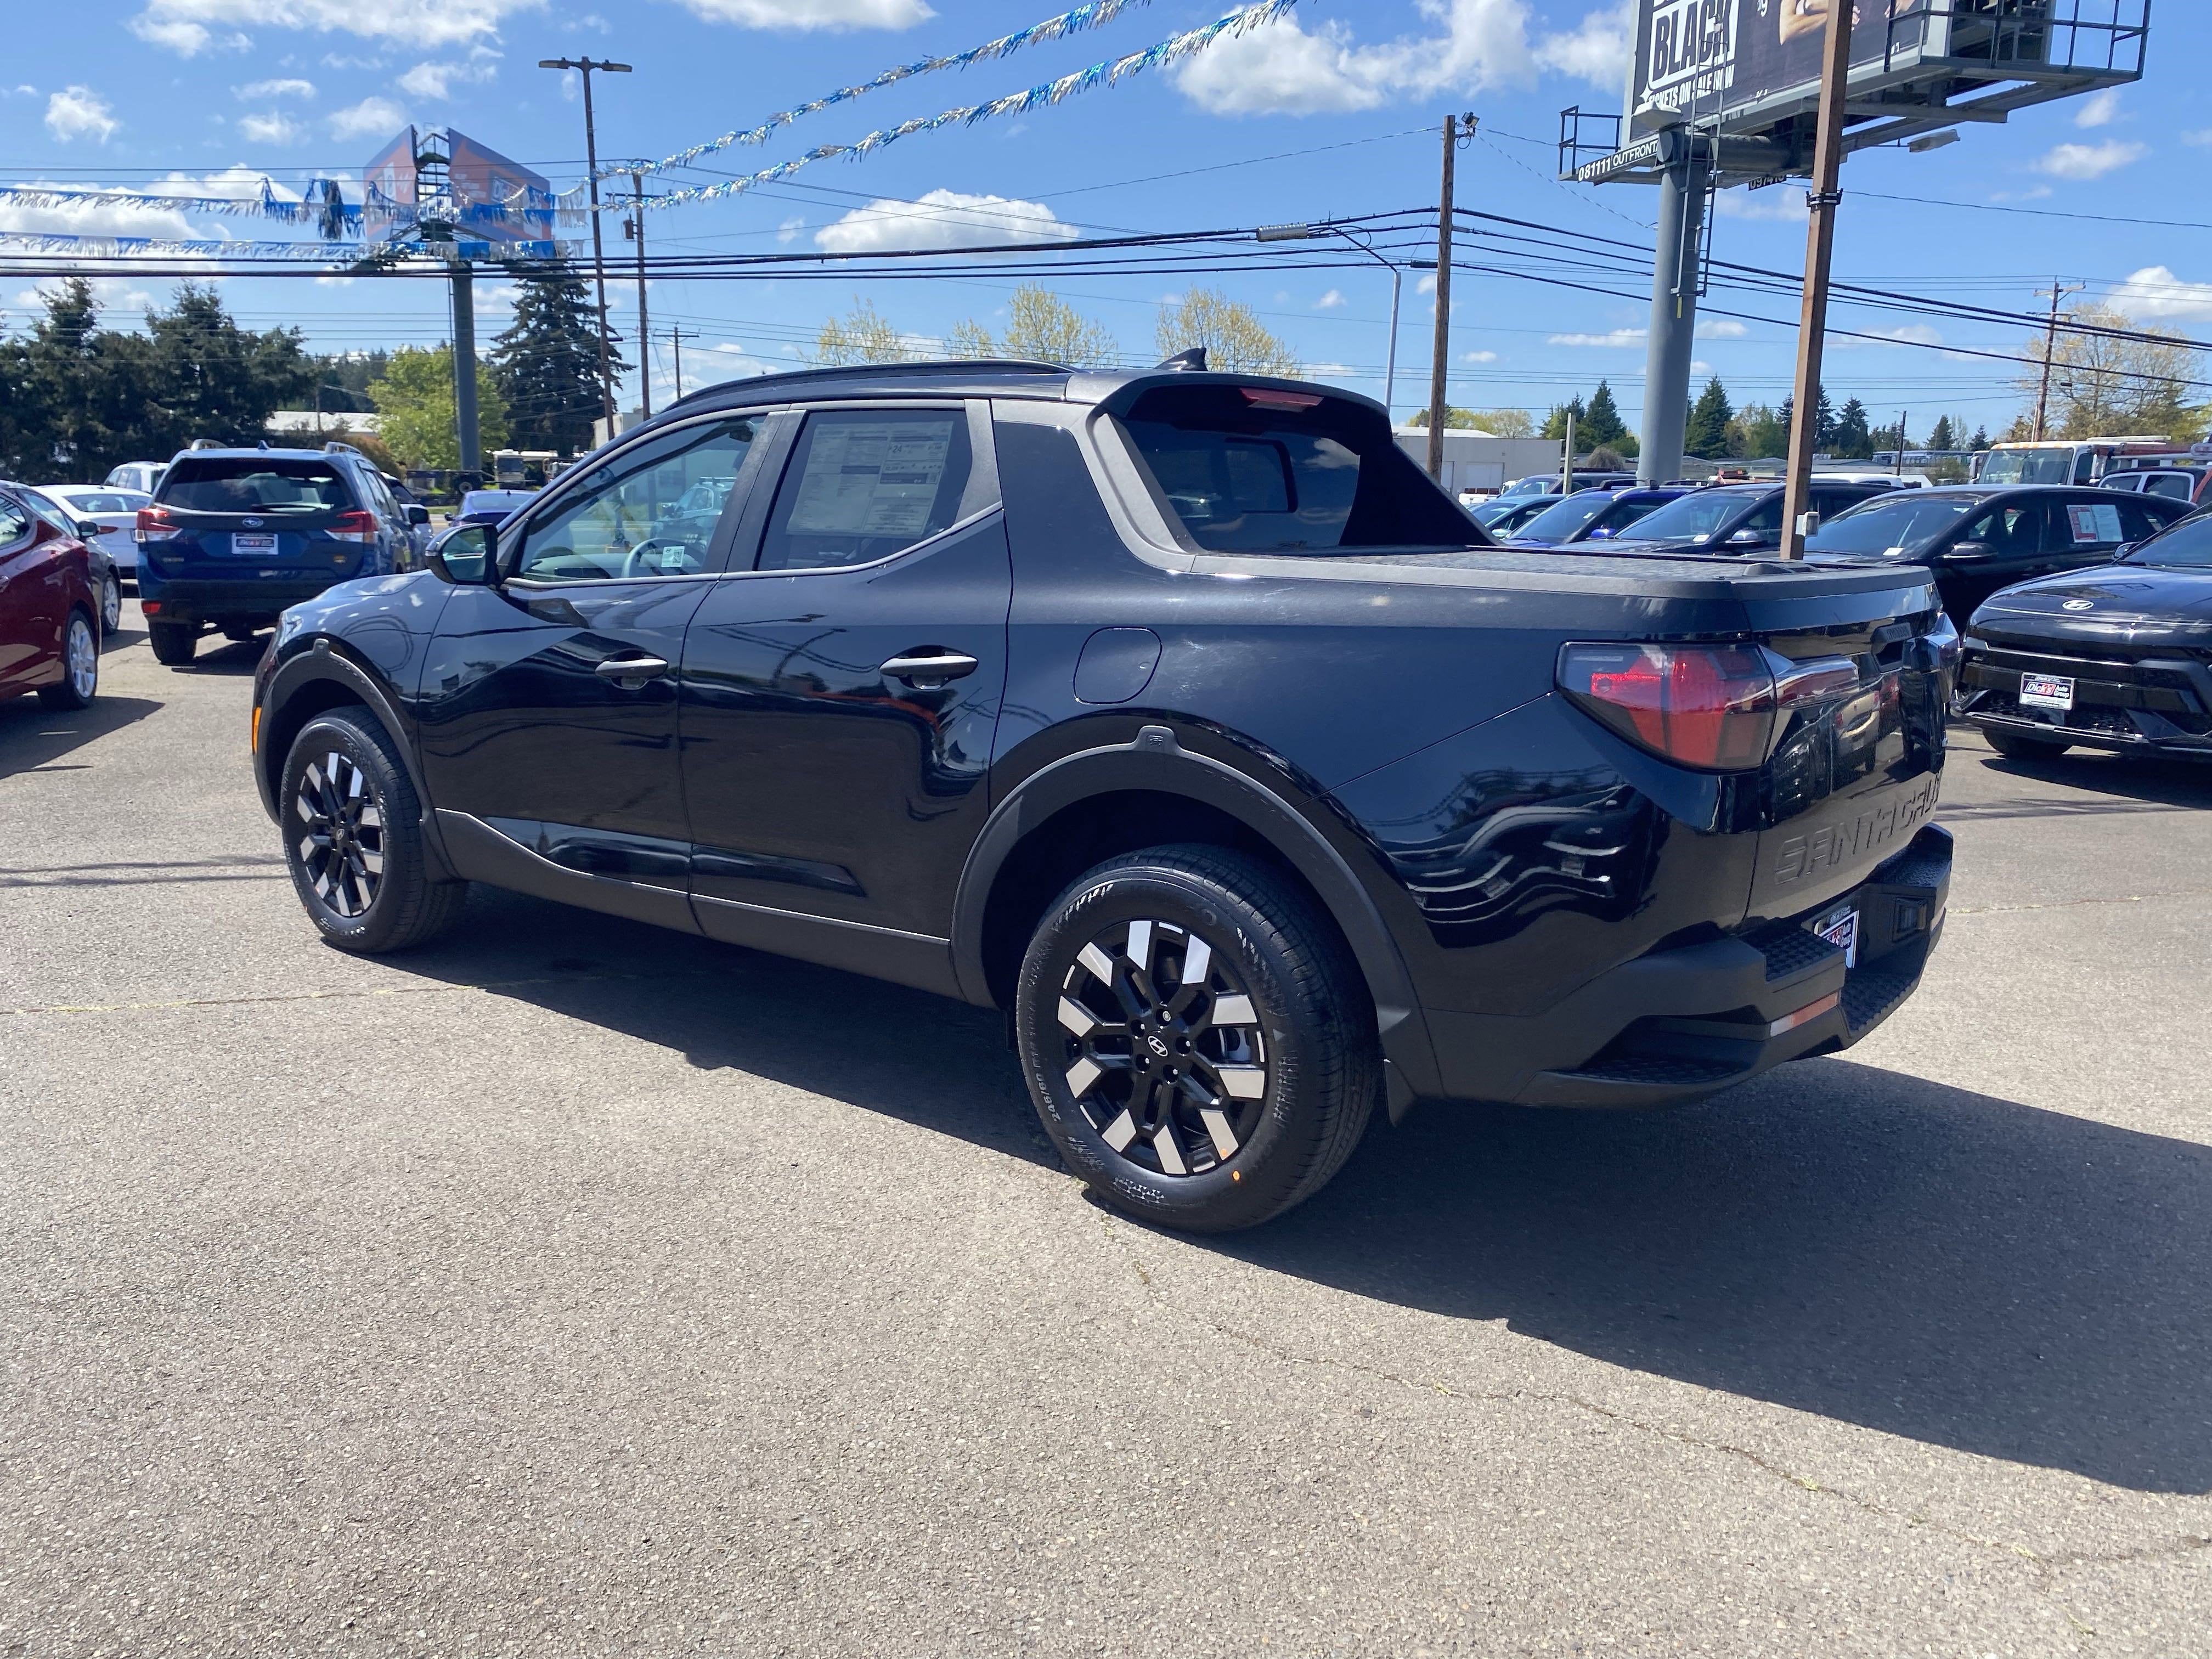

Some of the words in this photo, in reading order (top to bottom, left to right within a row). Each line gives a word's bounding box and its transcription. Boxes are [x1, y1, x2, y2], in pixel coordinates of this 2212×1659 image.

[1652, 0, 1731, 82] BLACK
[1679, 80, 1691, 105] ON
[1692, 72, 1713, 101] SALE
[1578, 157, 1611, 182] 081111
[2027, 682, 2053, 693] Dick's
[1774, 803, 1897, 885] SANTA
